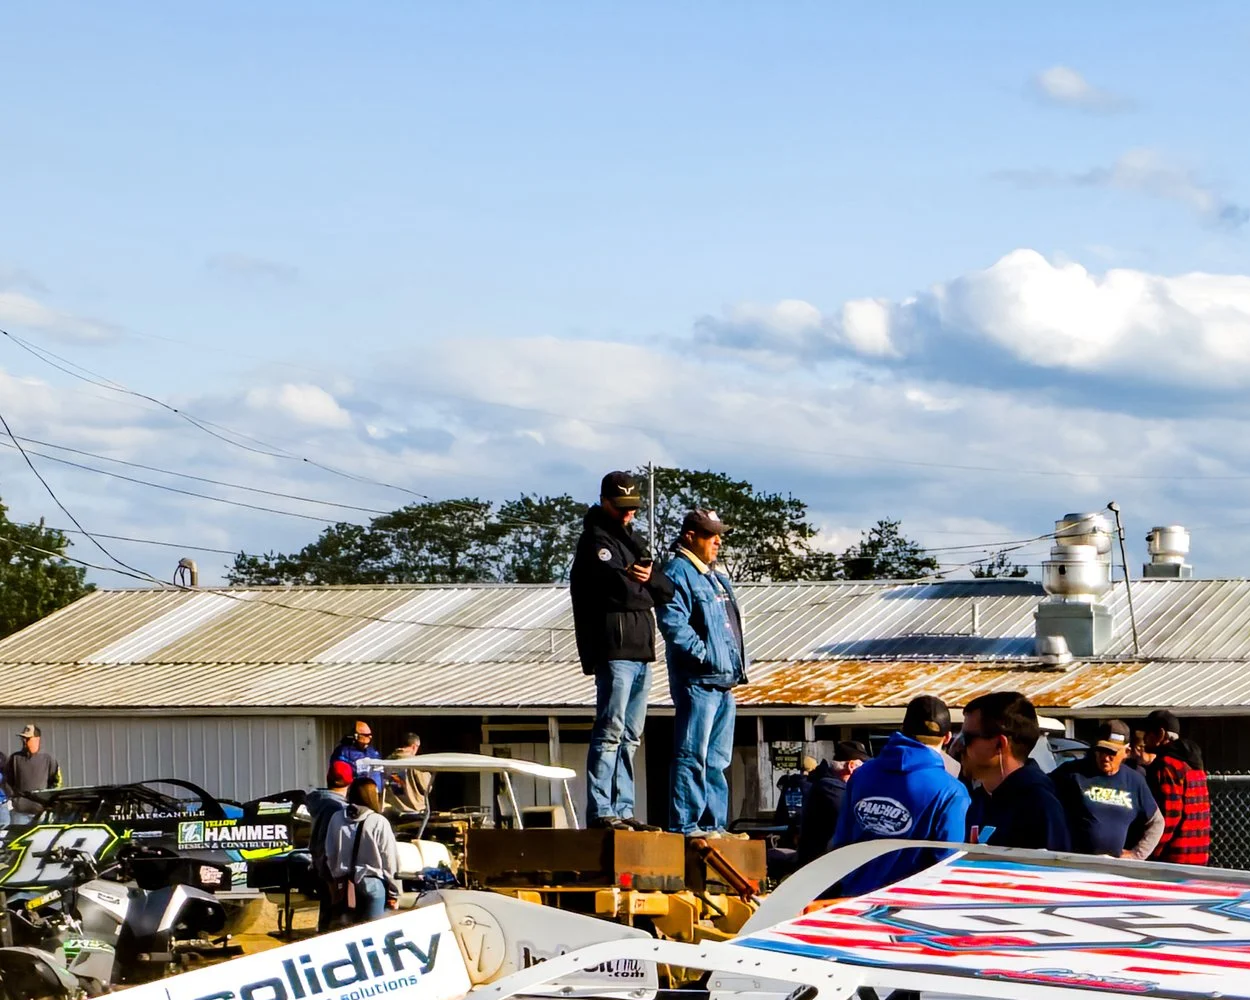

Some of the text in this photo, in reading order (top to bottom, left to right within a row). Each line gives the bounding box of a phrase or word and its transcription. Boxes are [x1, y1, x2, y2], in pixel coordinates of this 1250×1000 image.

[858, 800, 910, 822] PANCHO'S
[204, 825, 288, 841] HAMMER
[221, 840, 290, 850] CONSTRUCTION
